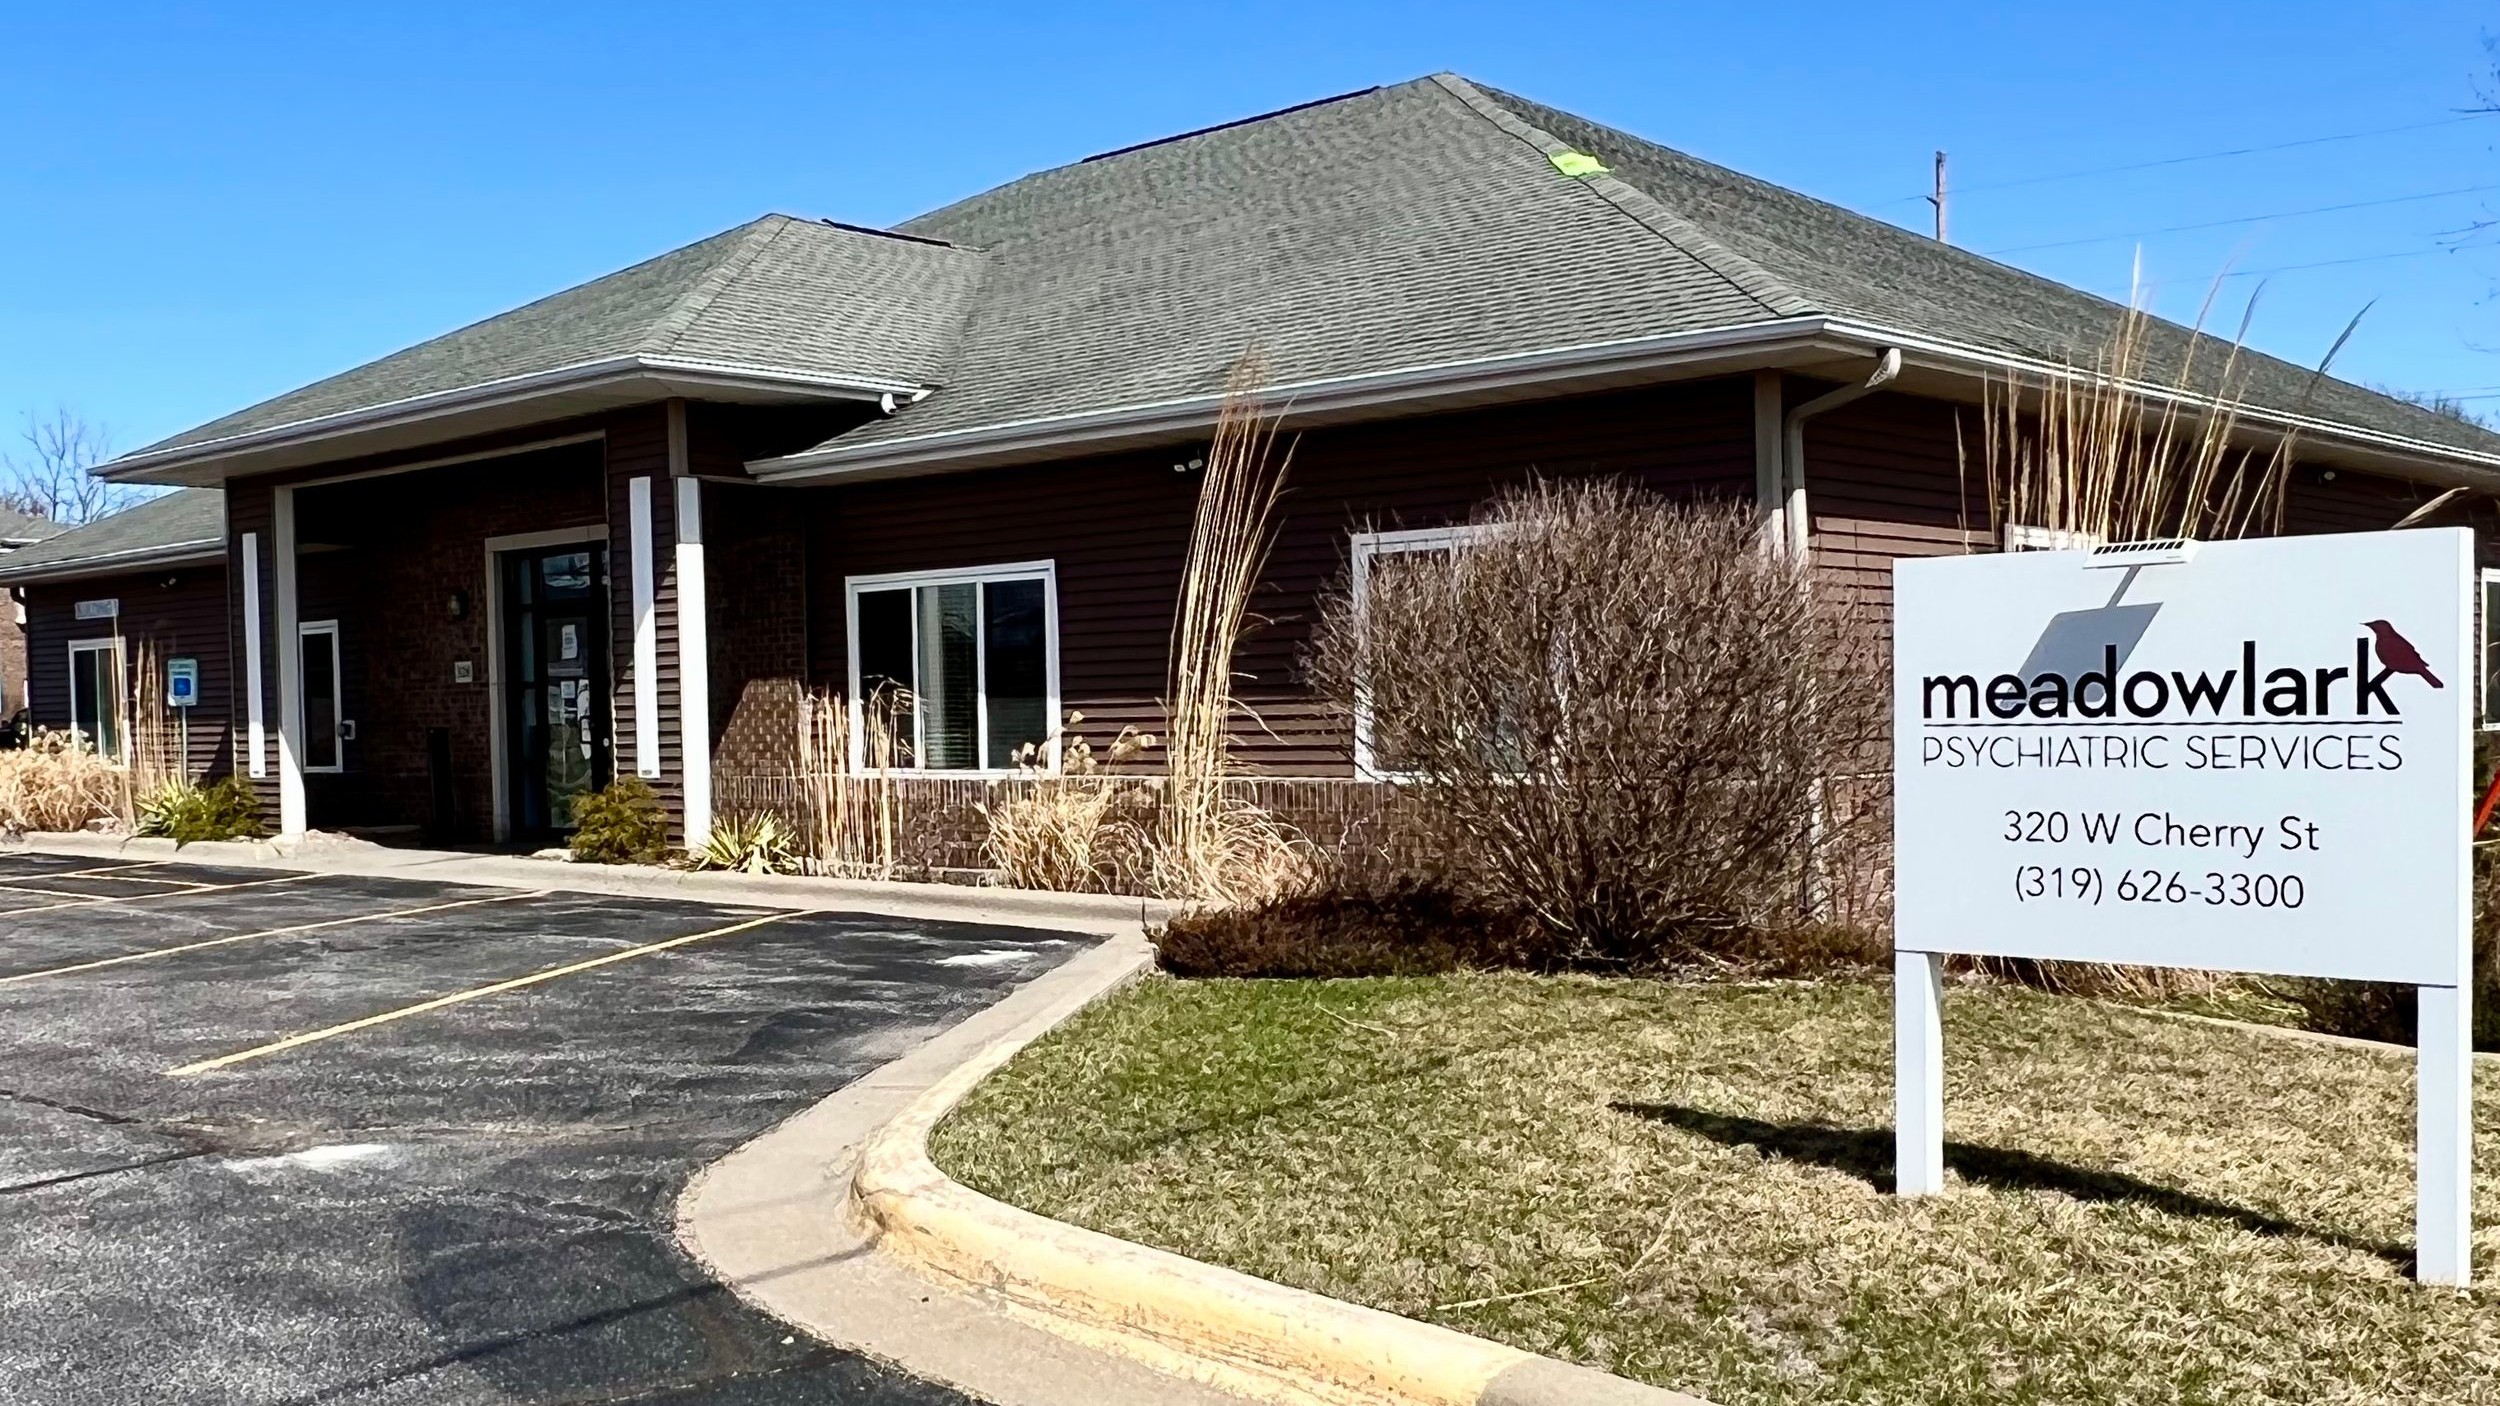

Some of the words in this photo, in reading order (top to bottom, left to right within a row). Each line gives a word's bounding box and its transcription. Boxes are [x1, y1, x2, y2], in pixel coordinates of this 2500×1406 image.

[1923, 637, 2402, 719] meadowlark
[1923, 735, 2169, 769] PSYCHIATRIC
[2184, 734, 2403, 771] SERVICES
[2003, 809, 2069, 843] 320
[2081, 812, 2121, 845] W
[2134, 811, 2265, 859] Cherry
[2279, 815, 2320, 851] St
[2015, 865, 2103, 906] (319)
[2117, 869, 2305, 909] 626-3300
